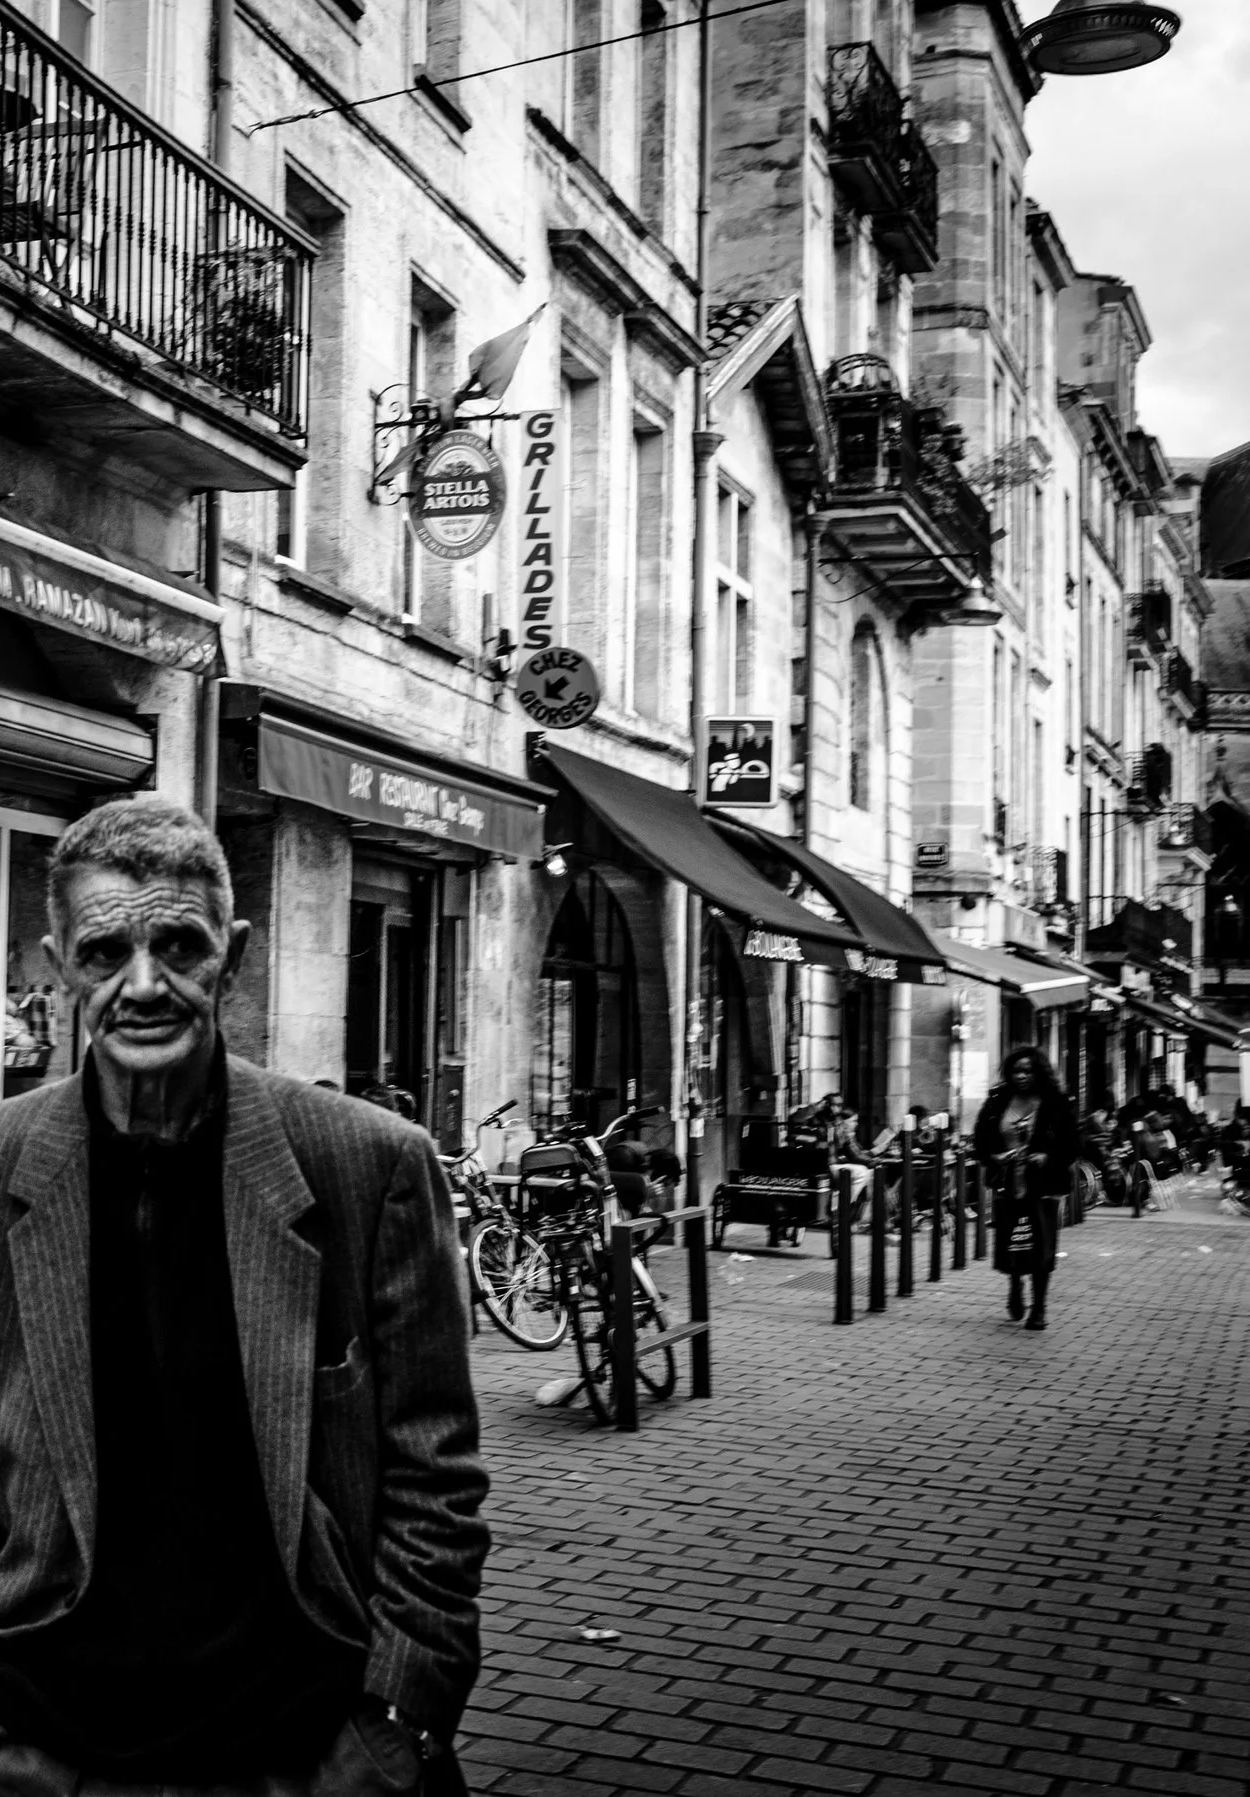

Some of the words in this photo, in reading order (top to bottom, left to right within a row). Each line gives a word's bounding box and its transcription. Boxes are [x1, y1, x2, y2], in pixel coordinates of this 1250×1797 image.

[423, 480, 490, 497] STELLA
[422, 493, 491, 511] ARTOIS
[522, 413, 555, 650] GRILLADES
[529, 652, 584, 676] CHEZ
[519, 690, 592, 725] GEORGES
